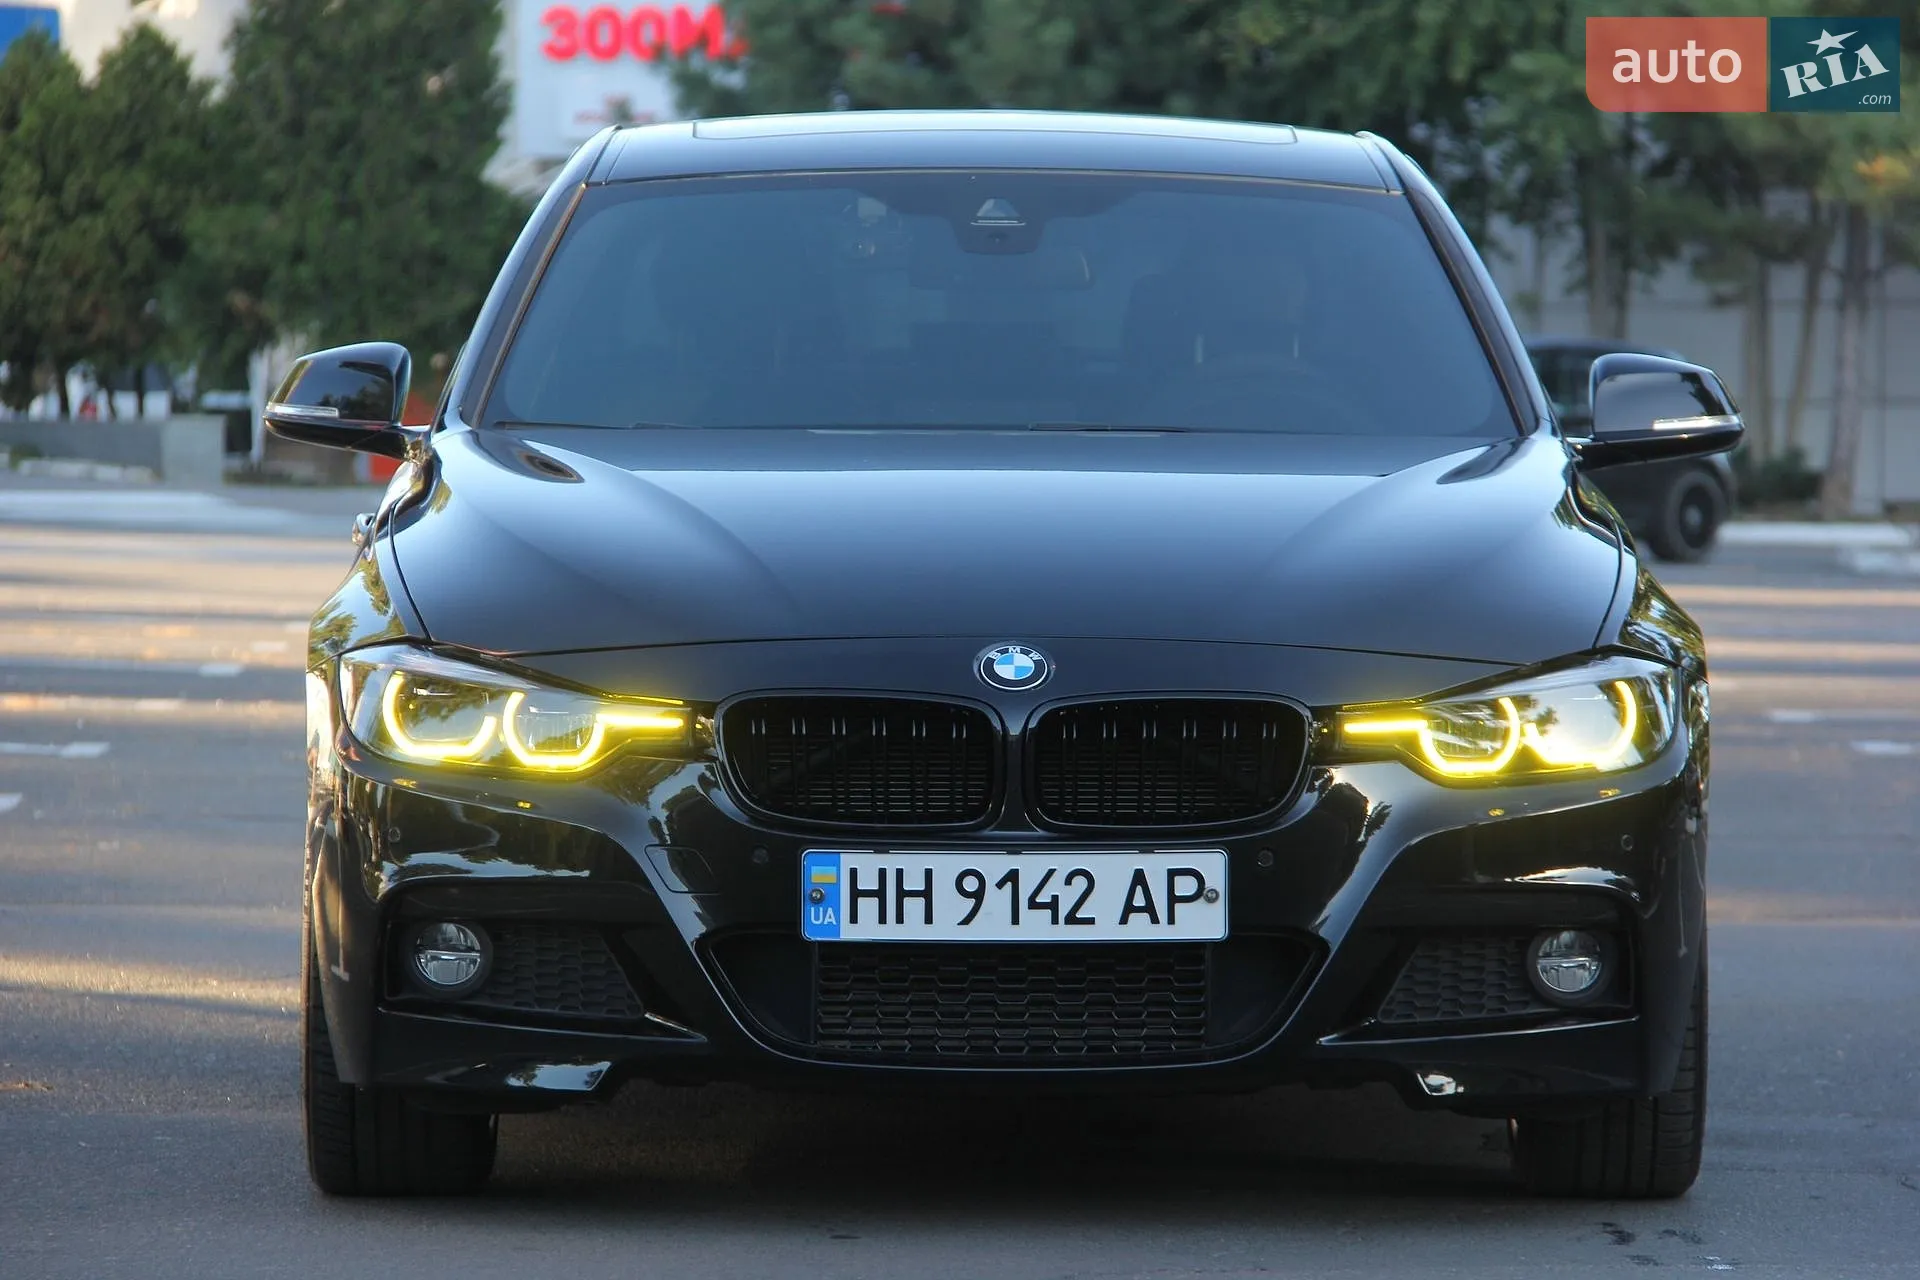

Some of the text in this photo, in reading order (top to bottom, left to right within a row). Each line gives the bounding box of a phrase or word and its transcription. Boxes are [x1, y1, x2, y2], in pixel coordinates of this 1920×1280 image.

[988, 646, 1042, 661] BMW
[849, 867, 1206, 926] HH 9142 AP
[810, 906, 837, 925] UA
